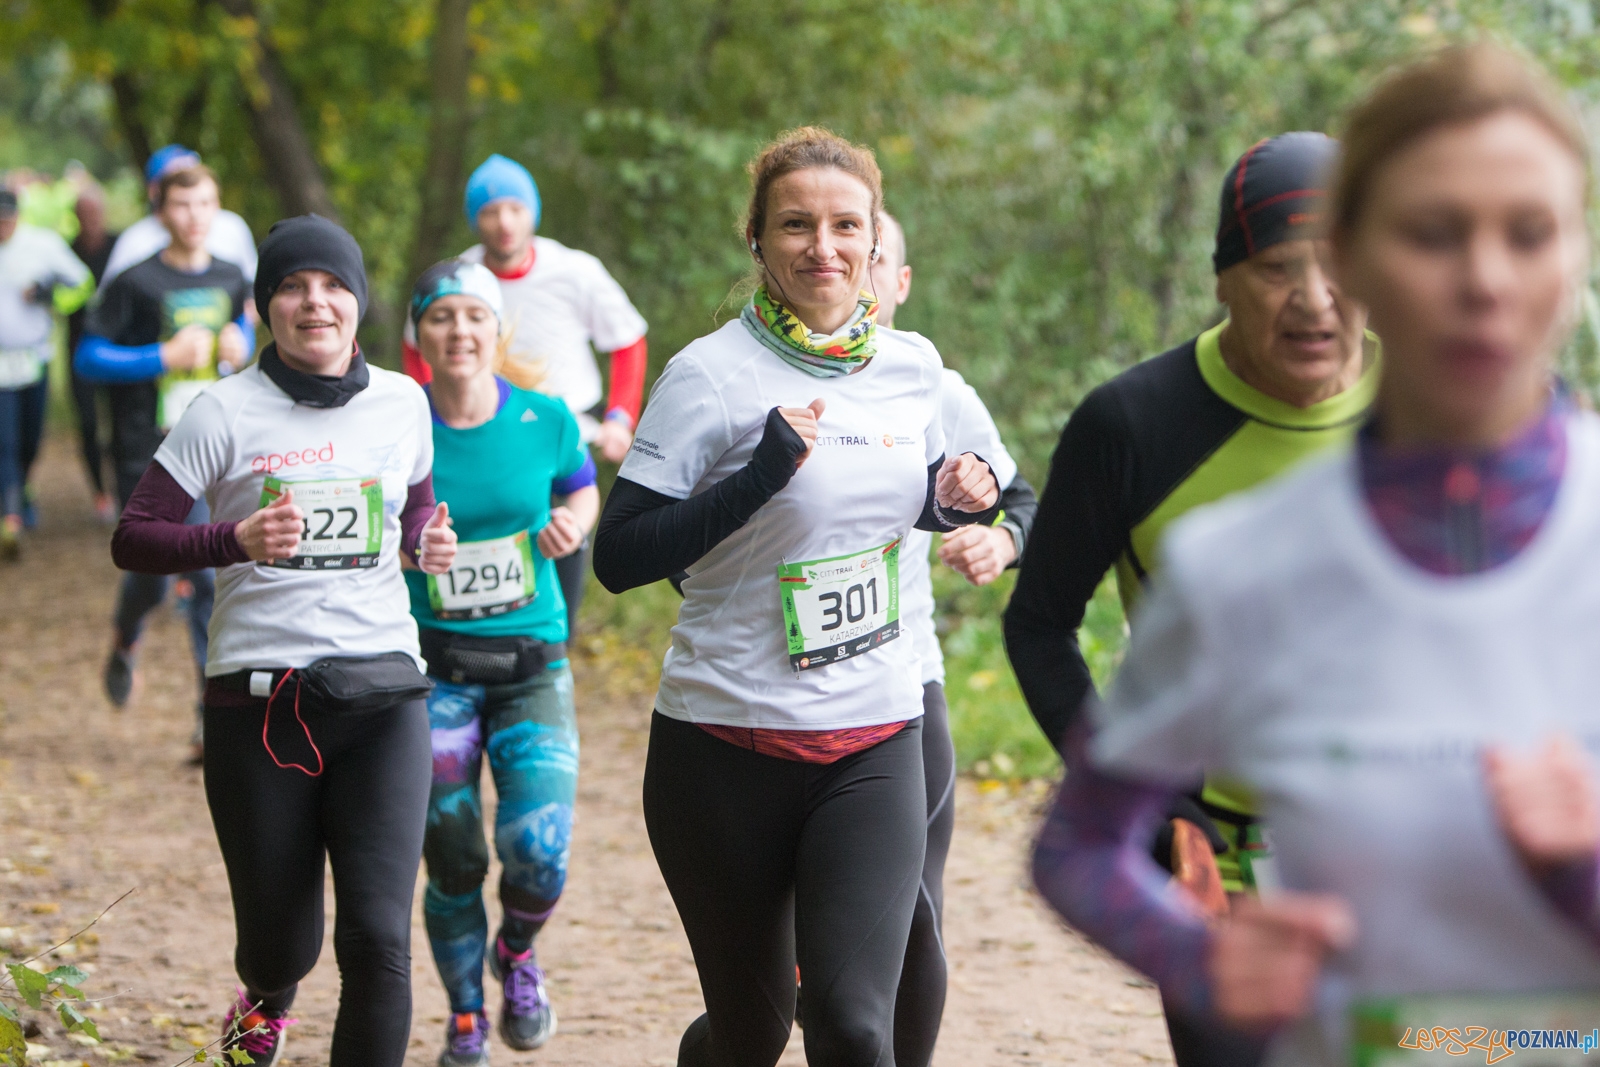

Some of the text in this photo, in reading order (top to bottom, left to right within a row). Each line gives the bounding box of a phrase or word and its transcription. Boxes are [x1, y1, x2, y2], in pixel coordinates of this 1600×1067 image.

[251, 441, 334, 475] speed
[300, 544, 342, 553] PATRYCJA
[447, 559, 522, 596] 1294
[818, 577, 878, 632] 301
[829, 621, 874, 644] KATARZYNA
